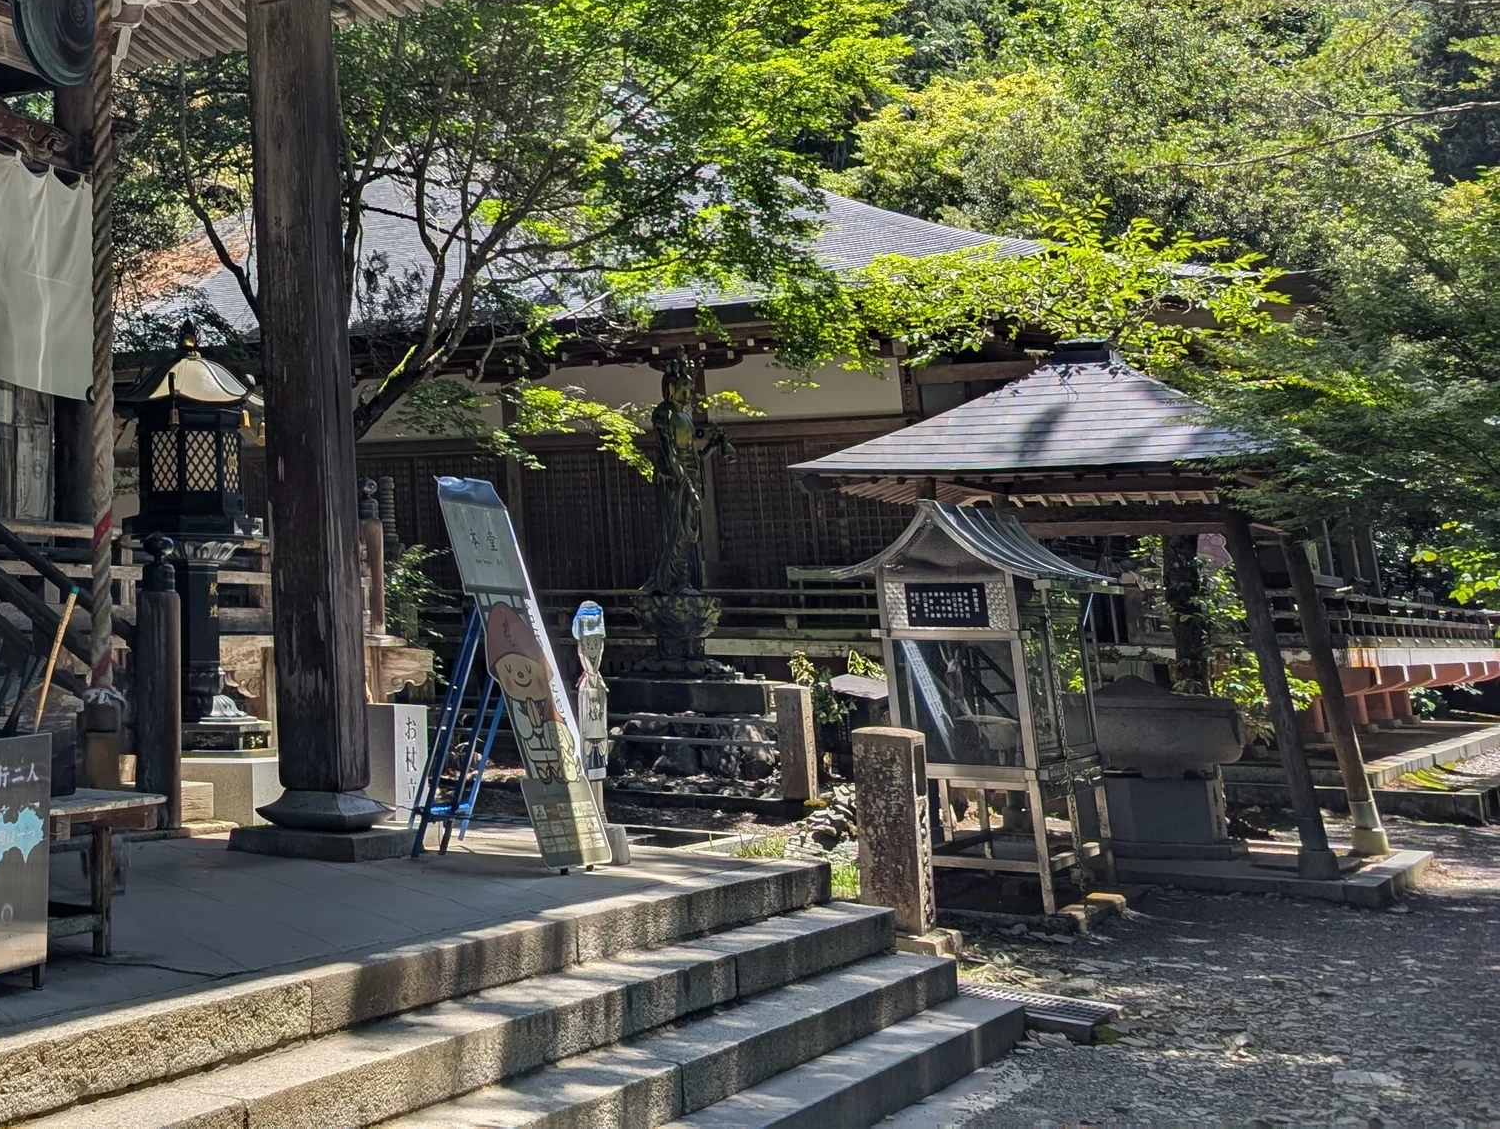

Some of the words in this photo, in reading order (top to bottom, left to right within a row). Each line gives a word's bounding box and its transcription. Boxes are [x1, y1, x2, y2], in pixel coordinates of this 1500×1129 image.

[469, 527, 499, 552] 本堂
[405, 716, 417, 803] お杖立
